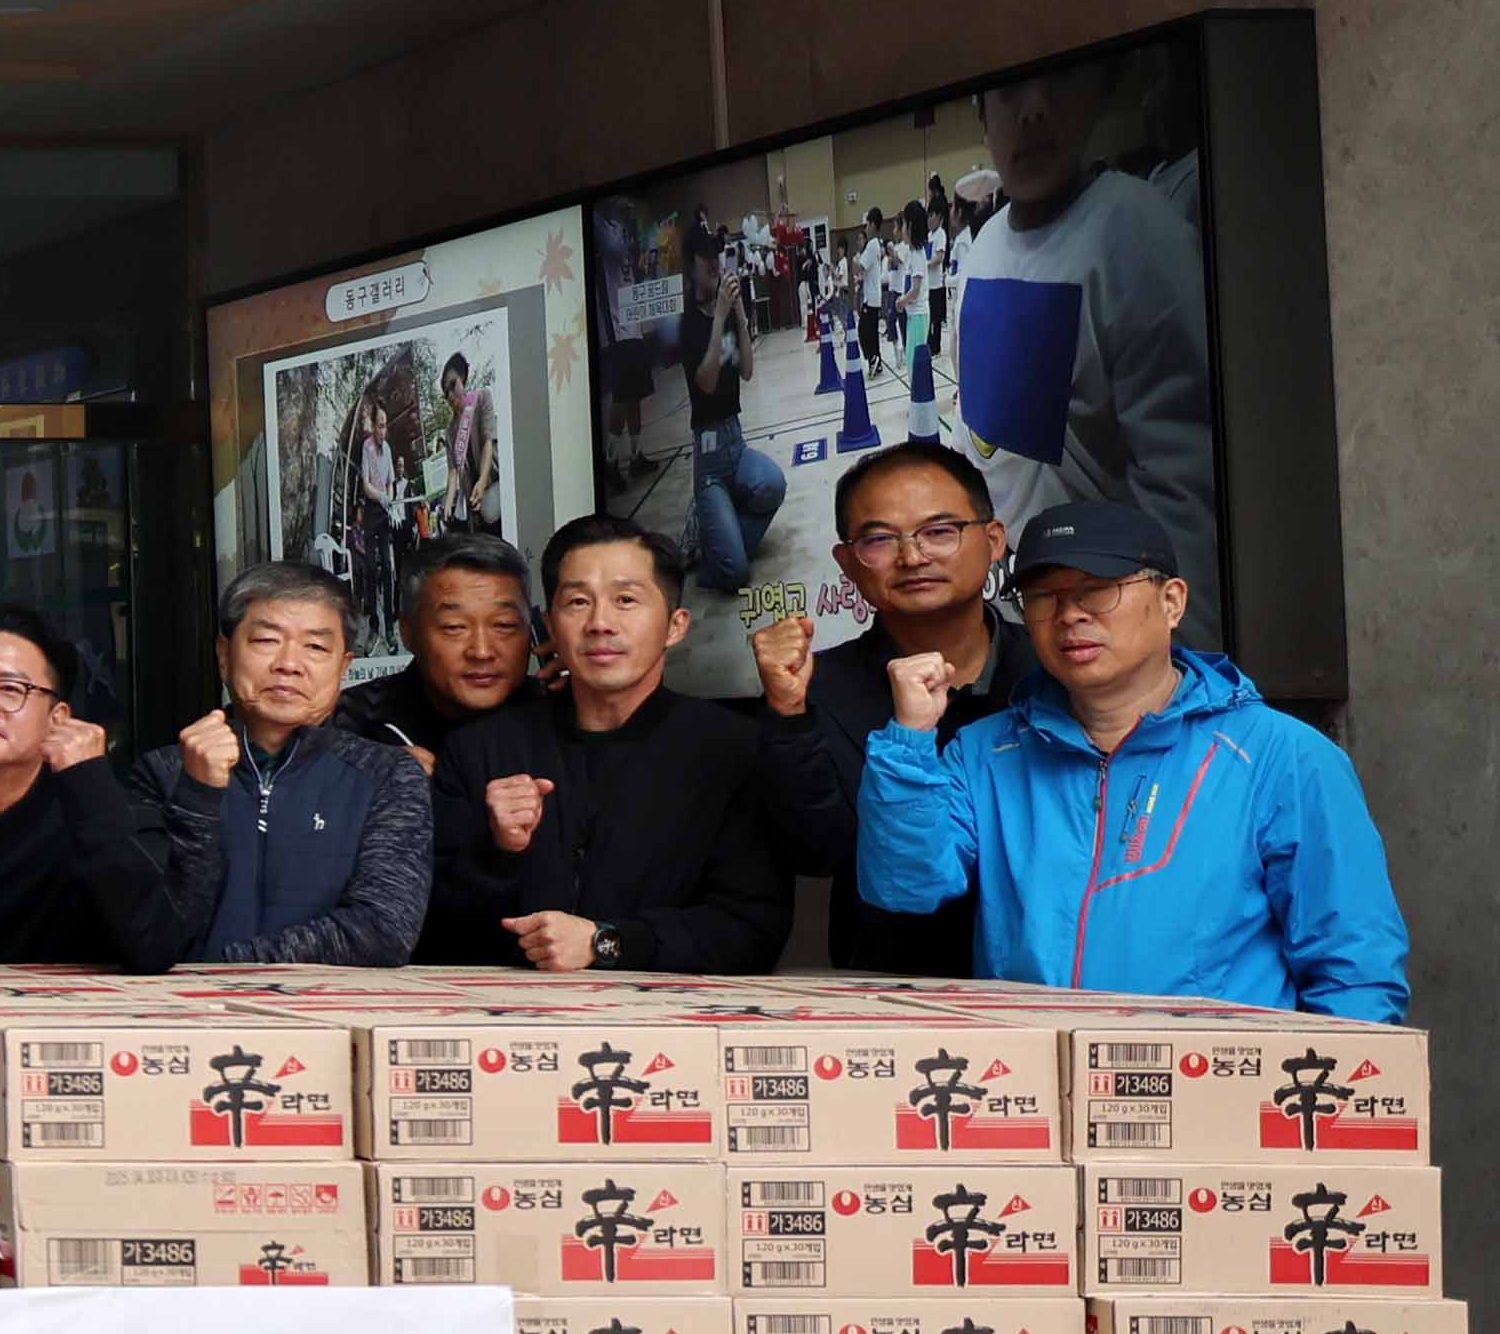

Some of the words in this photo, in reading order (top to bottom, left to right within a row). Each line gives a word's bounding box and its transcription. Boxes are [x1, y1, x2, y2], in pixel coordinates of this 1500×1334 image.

[141, 1055, 190, 1075] 농심
[845, 1059, 896, 1079] 농심
[1211, 1058, 1262, 1077] 농심
[49, 1073, 100, 1094] 가3486
[754, 1077, 805, 1098] 가3486
[1117, 1075, 1169, 1094] 가3486
[205, 1047, 280, 1147] 辛
[281, 1091, 332, 1114] 라면
[910, 1049, 987, 1150] 辛
[987, 1094, 1039, 1117] 라면
[1274, 1048, 1355, 1150] 辛
[1354, 1095, 1406, 1117] 라면
[125, 1241, 193, 1266] 가3486
